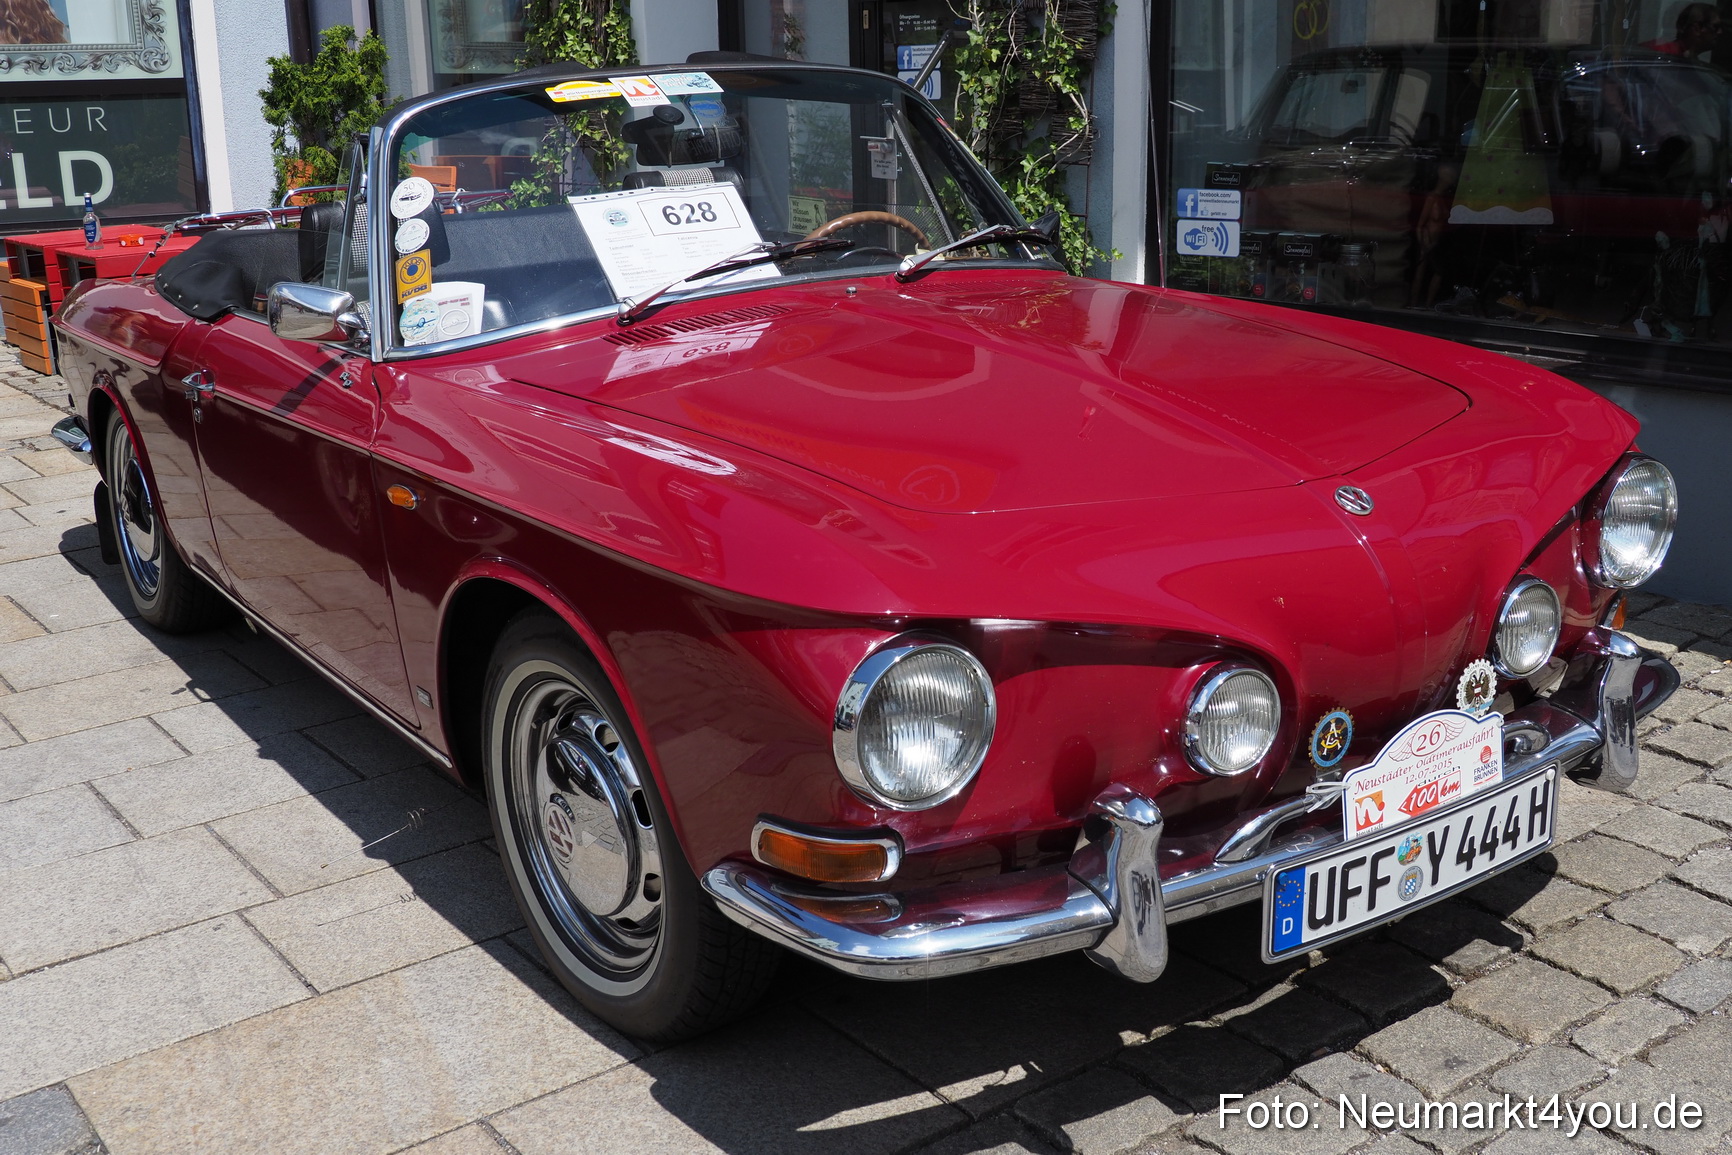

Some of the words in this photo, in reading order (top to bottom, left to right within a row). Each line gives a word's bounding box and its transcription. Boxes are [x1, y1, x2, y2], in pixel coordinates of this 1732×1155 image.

[0, 150, 114, 209] LD
[662, 201, 717, 226] 628
[1201, 225, 1214, 233] free
[1416, 724, 1441, 752] 26
[1354, 764, 1414, 795] Neustädter
[1416, 725, 1495, 768] Oldtimerausfahrt
[1405, 757, 1453, 785] 12.07.2015
[1473, 759, 1498, 775] FRANKEN
[1409, 784, 1436, 812] 100
[1440, 778, 1460, 797] km
[1307, 846, 1396, 930] UFF
[1282, 917, 1293, 936] D
